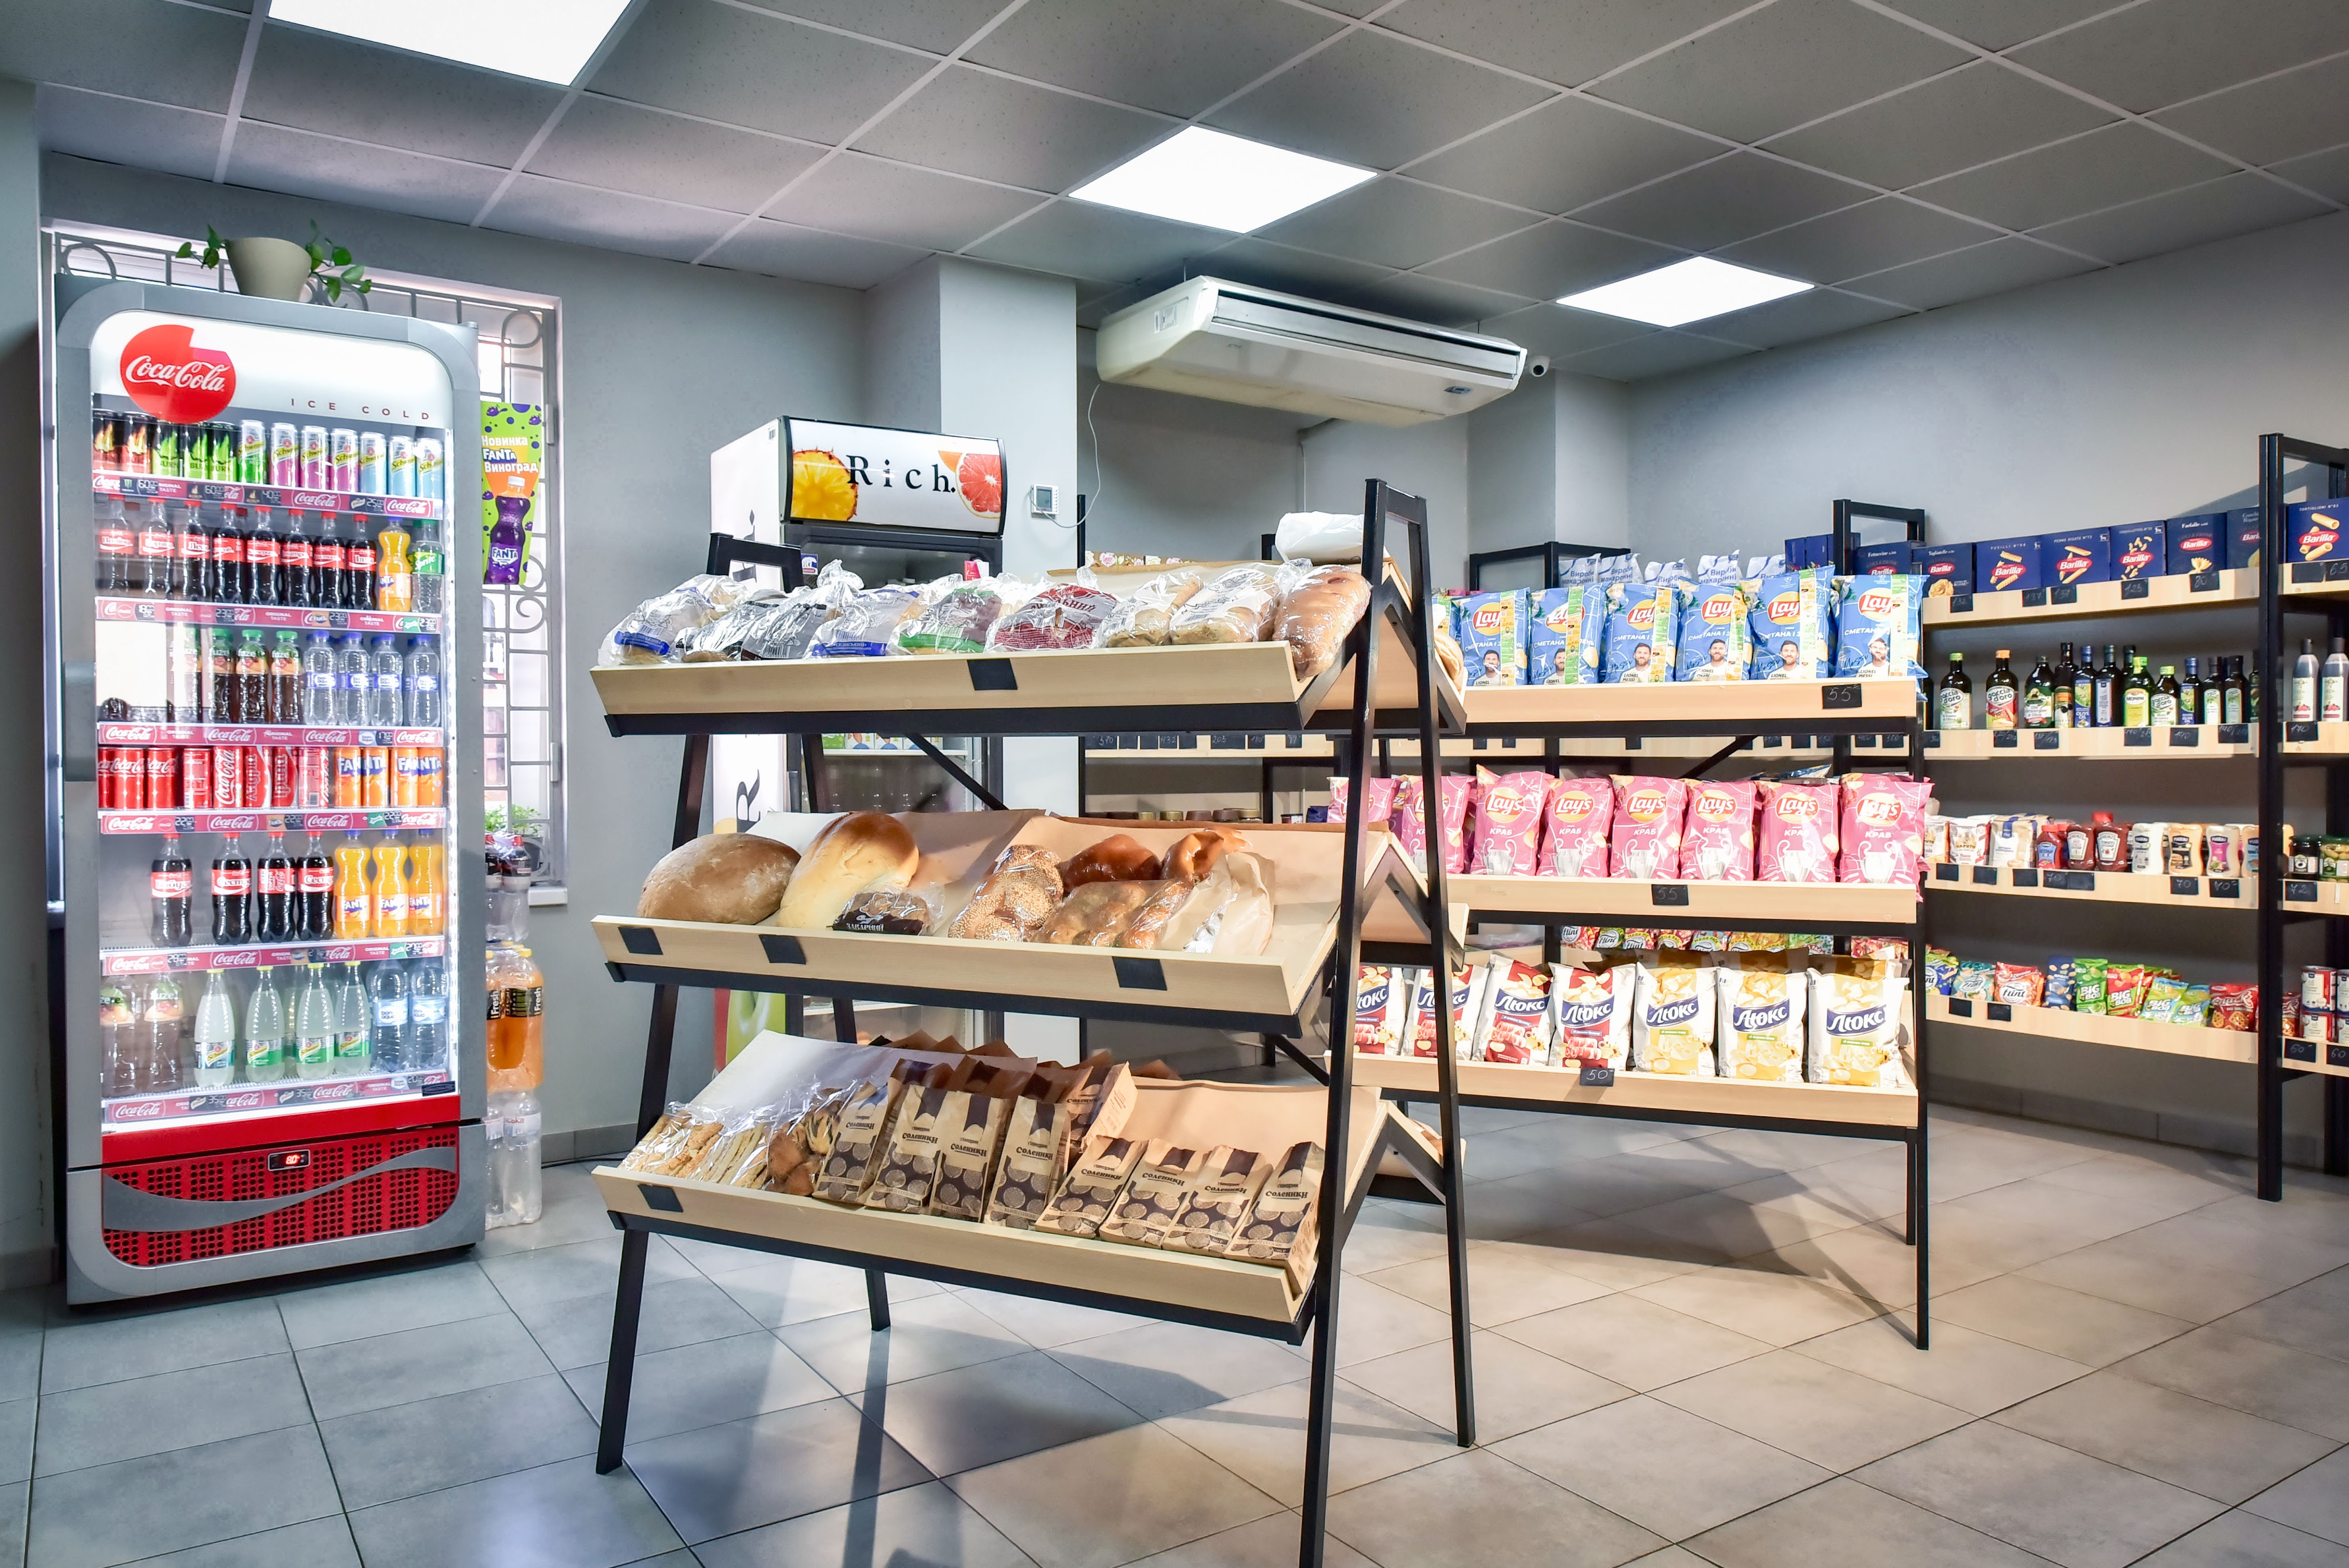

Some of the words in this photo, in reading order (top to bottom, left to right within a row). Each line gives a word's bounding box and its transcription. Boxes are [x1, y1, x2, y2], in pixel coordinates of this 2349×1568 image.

[125, 355, 231, 392] Coca-Cola
[291, 397, 336, 411] ICE
[362, 406, 429, 420] COLD
[481, 436, 529, 447] Новинка
[483, 448, 517, 461] FANTA
[484, 462, 539, 474] Виноград
[294, 492, 337, 507] Coca-Cola
[387, 499, 427, 514] Coca-Cola
[2182, 540, 2208, 549] Barilla
[2302, 534, 2336, 544] Barilla
[492, 548, 518, 559] FANTA
[2122, 554, 2150, 563] Barilla
[415, 555, 436, 571] Sprite
[1930, 563, 1953, 574] Barilla
[2060, 560, 2088, 570] Barilla
[1611, 565, 1633, 575] Вироби
[1710, 566, 1736, 576] Вироби
[1995, 567, 2023, 576] Barilla
[1601, 574, 1633, 585] макаронні
[1701, 574, 1736, 585] макаронні
[1704, 600, 1733, 620] Lay
[1770, 600, 1799, 620] Lay
[1861, 595, 1891, 614] Lay
[1475, 610, 1500, 630] Lay
[1629, 607, 1655, 628] Lay
[1688, 631, 1721, 641] СМЕТАНА
[1534, 639, 1565, 648] СМЕТАНА
[1987, 689, 2011, 701] goccia
[1994, 693, 2012, 702] d'oro
[207, 729, 253, 742] Coca-Cola
[305, 730, 347, 743] Coca-Cola
[397, 731, 436, 744] Coca-Cola
[214, 749, 234, 805] Coca-Cola
[1486, 794, 1523, 814] Lay's
[1555, 795, 1594, 814] Lay's
[1628, 796, 1666, 814] Lay's
[1698, 796, 1734, 814] Lay's
[1778, 796, 1816, 815] Lay's
[108, 817, 154, 831] Coca-Cola
[210, 815, 255, 829] Coca-Cola
[307, 815, 349, 829] Coca-Cola
[846, 922, 884, 931] ЗАВАРНИЙ
[213, 953, 258, 966] Coca-Cola
[2081, 985, 2100, 994] BIG
[2086, 992, 2101, 1000] BOB
[2111, 991, 2131, 1001] BIG
[1495, 995, 1546, 1013] Люкс
[2149, 999, 2170, 1008] BIG
[2182, 1003, 2201, 1012] BIG
[1562, 1004, 1611, 1024] Люкс
[1650, 1002, 1698, 1024] Люкс
[1734, 1007, 1787, 1030] Люкс
[1829, 1011, 1884, 1033] Люкс
[313, 1084, 354, 1099] Coca-Cola
[115, 1103, 160, 1118] Coca-Cola
